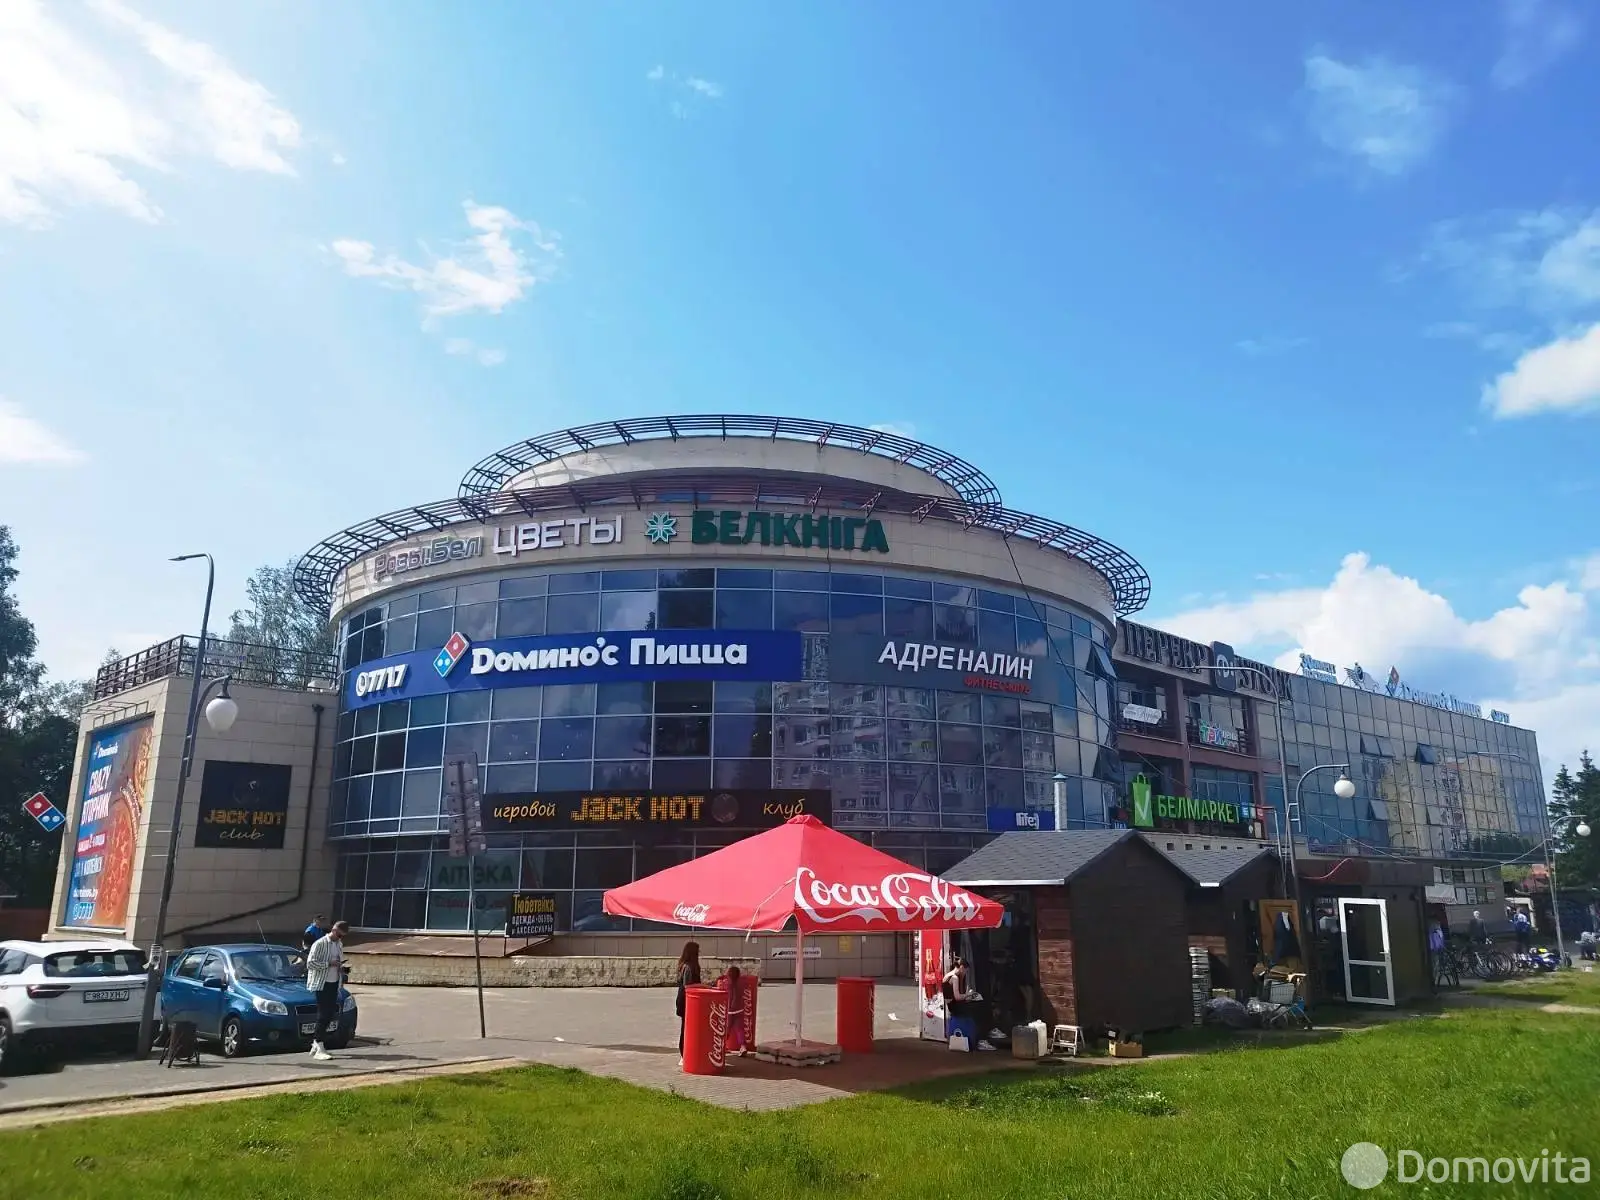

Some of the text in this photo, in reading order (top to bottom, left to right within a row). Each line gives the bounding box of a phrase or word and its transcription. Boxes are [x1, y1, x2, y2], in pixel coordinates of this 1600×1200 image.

[492, 515, 622, 557] ЦВЕТЫ
[691, 510, 889, 553] БЕЛКНІГА
[629, 638, 748, 665] Пицца
[878, 641, 1033, 680] АДРЕНАЛИН
[494, 800, 556, 823] игровой
[650, 796, 705, 821] HOT
[763, 798, 806, 823] клуб
[1158, 795, 1241, 824] БЕЛМАРКЕТ
[219, 828, 264, 840] club
[512, 894, 555, 914] Тюбетейка
[794, 866, 981, 924] Coca-Cola
